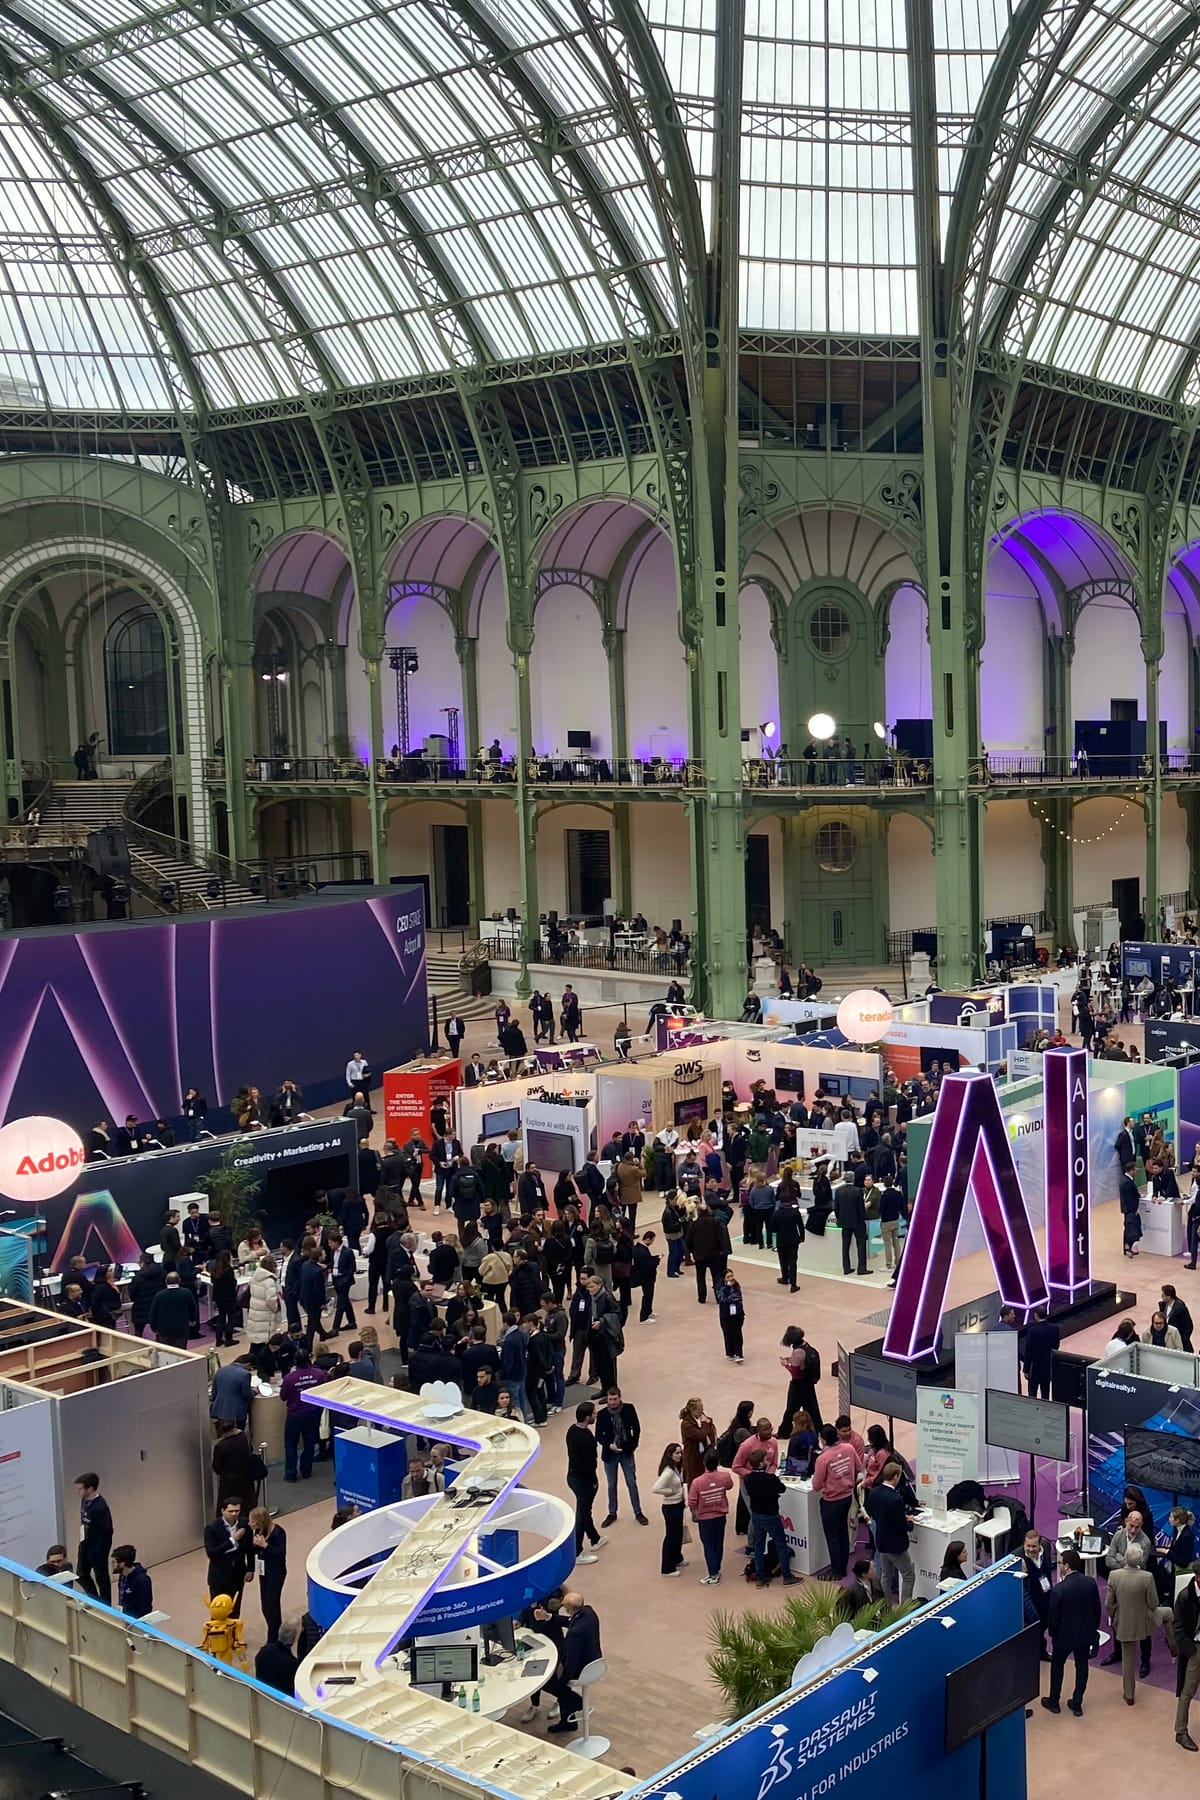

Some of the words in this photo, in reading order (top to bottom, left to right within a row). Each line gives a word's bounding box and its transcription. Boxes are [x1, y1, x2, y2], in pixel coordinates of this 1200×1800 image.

[397, 915, 409, 933] CEO
[746, 1049, 761, 1060] aws
[674, 1060, 703, 1081] aws
[526, 1085, 545, 1097] aws
[539, 1091, 565, 1106] aws
[526, 1117, 545, 1129] Explore
[553, 1122, 565, 1131] with
[566, 1125, 580, 1134] AWS
[234, 1151, 275, 1167] Creativity
[283, 1141, 325, 1158] Marketing
[331, 1138, 342, 1148] AI
[1072, 1077, 1086, 1255] Adopt
[1095, 1379, 1137, 1394] digitalrealty.fr
[444, 1606, 475, 1619] Financial
[476, 1598, 504, 1612] Services
[453, 1601, 468, 1610] 360
[799, 1690, 878, 1753] DASSAULT
[812, 1773, 836, 1799] FOR
[839, 1721, 909, 1781] INDUSTRIES
